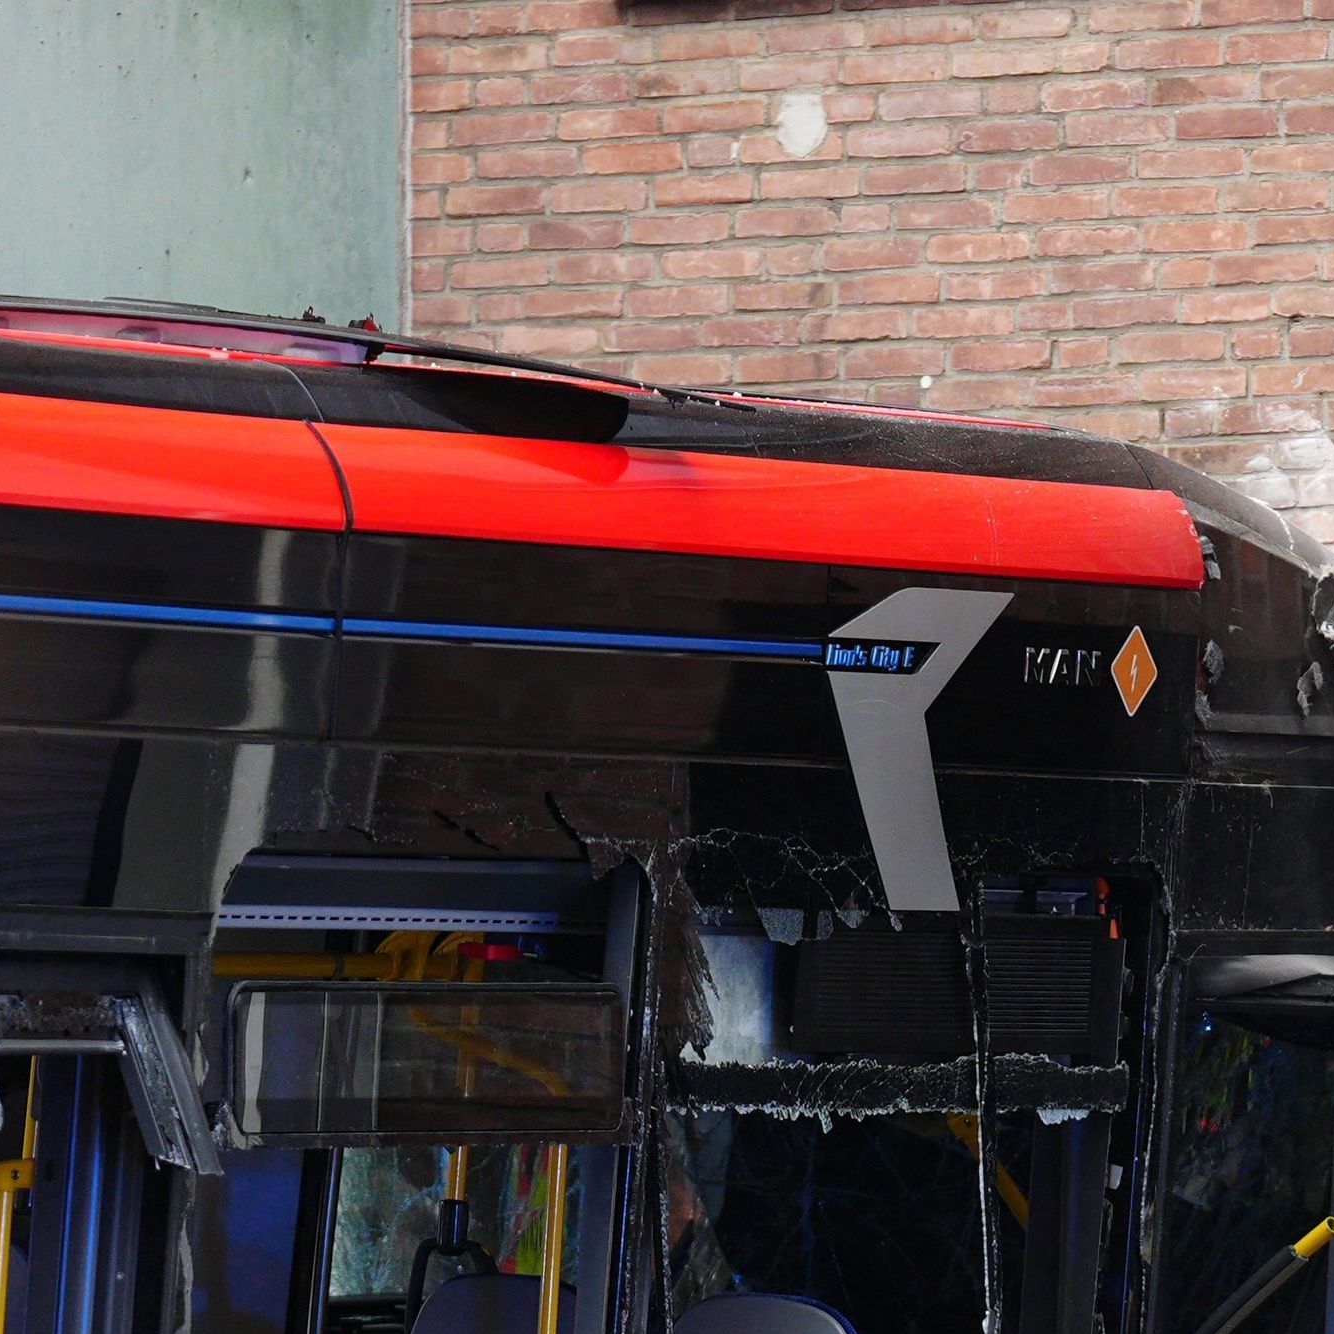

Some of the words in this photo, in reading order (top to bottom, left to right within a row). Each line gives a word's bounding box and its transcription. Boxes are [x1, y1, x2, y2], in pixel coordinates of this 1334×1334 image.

[826, 643, 868, 667] Lion's
[871, 645, 900, 672] City
[904, 646, 915, 668] E
[1024, 646, 1101, 686] MAN
